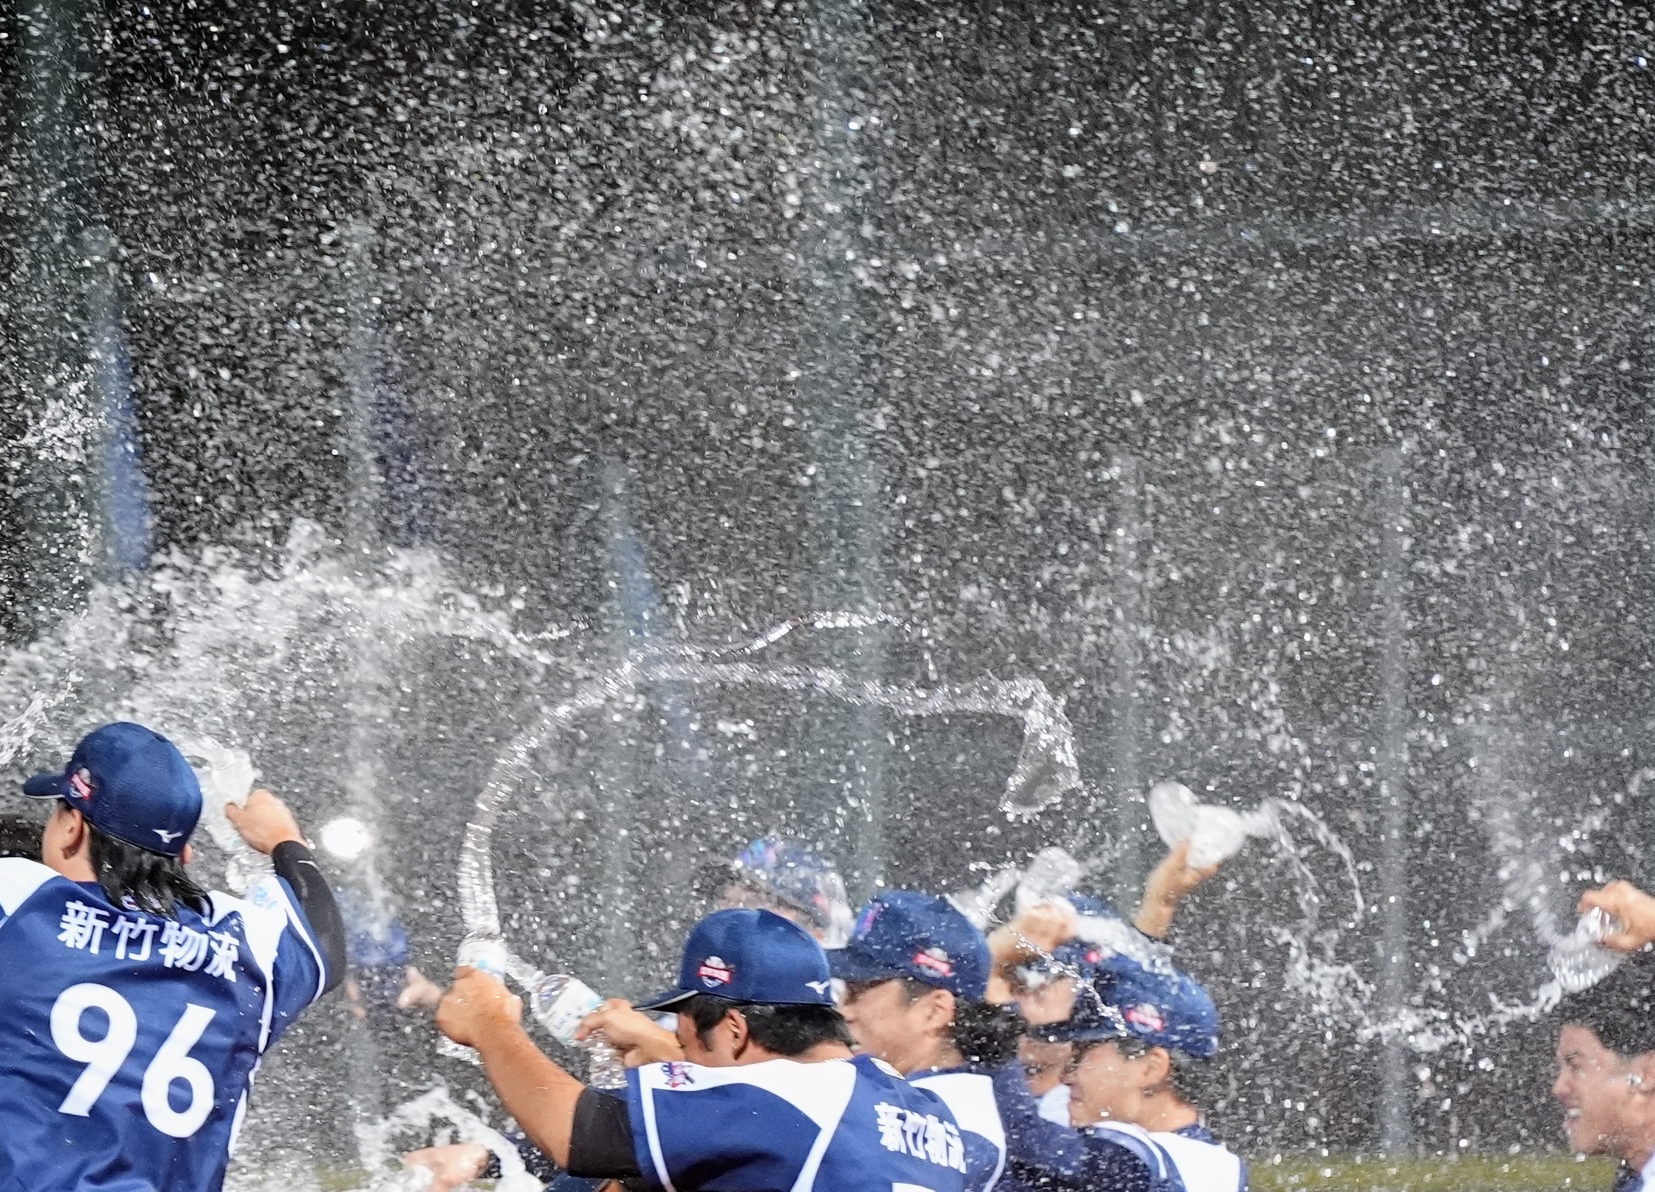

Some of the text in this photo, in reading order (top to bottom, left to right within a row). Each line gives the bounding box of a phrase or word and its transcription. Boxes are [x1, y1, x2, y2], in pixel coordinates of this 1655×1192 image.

[57, 900, 240, 983] 新竹物流
[50, 982, 216, 1138] 96
